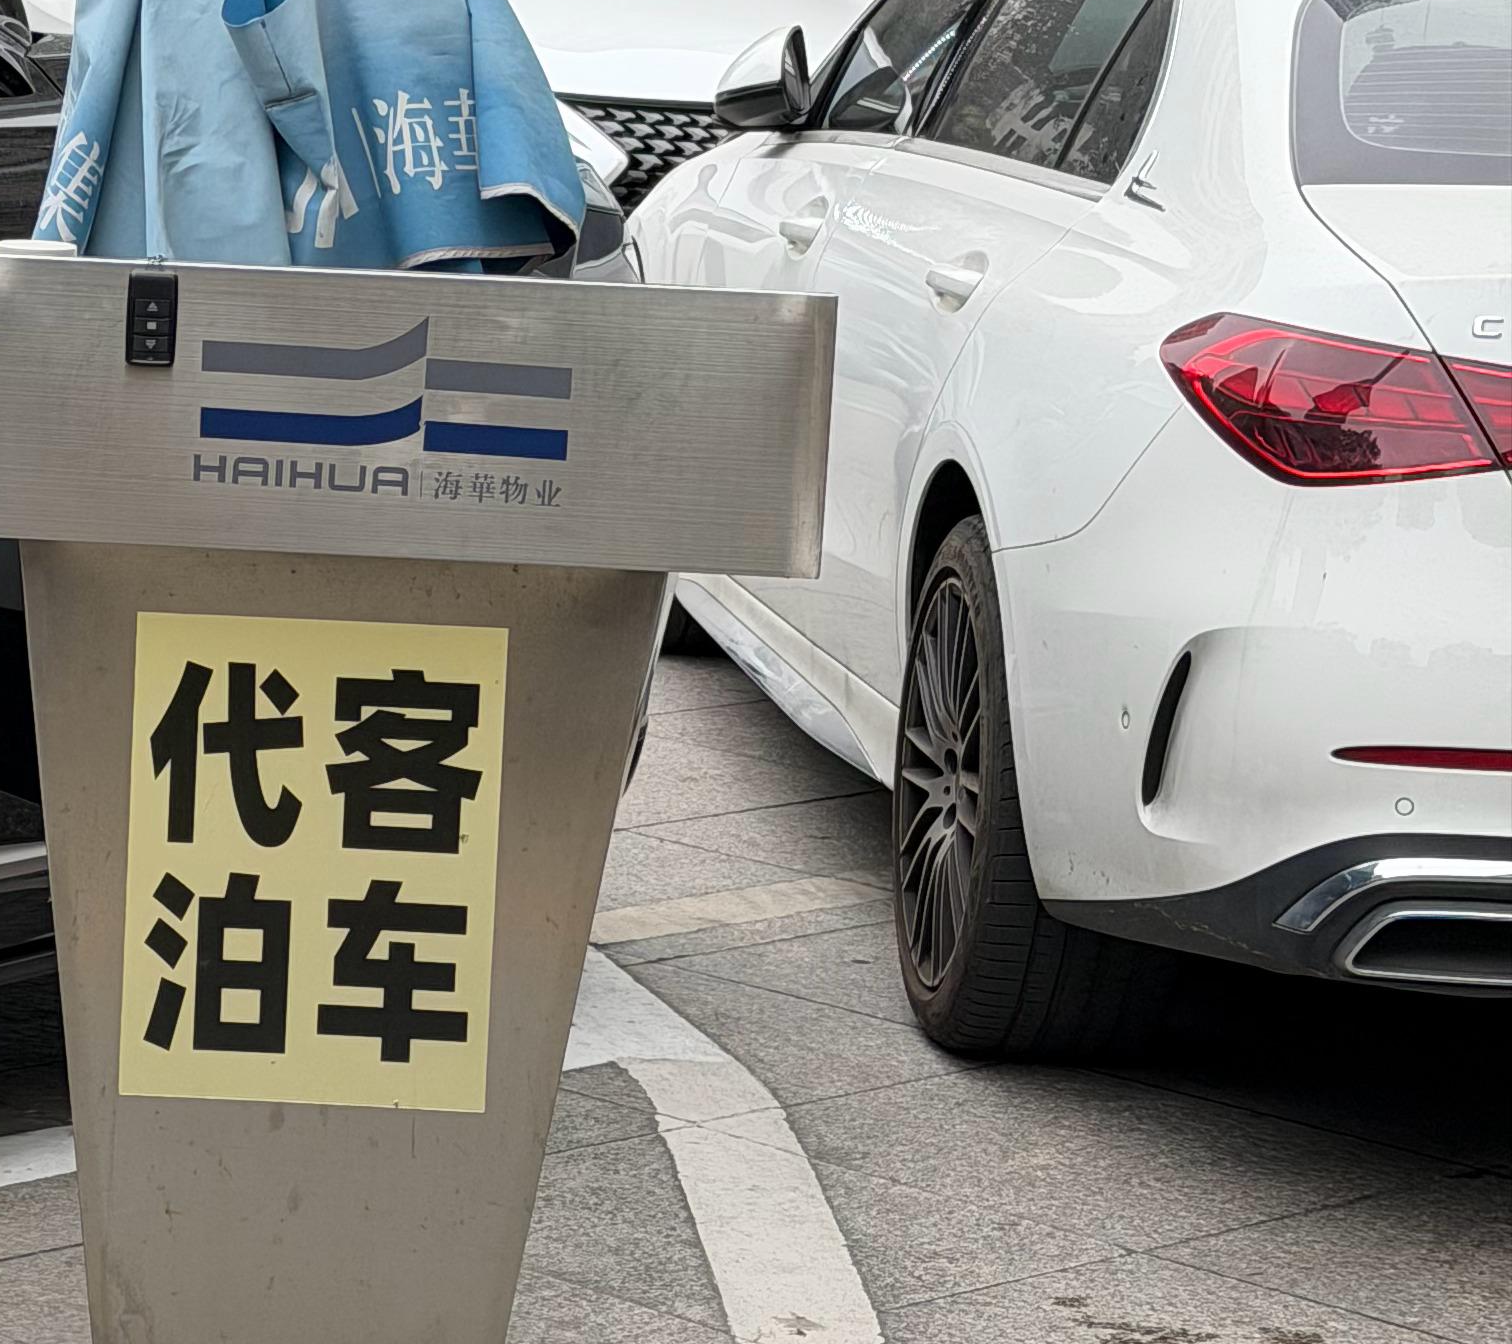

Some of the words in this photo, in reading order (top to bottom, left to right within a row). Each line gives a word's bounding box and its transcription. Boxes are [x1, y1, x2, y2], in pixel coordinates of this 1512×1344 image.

[192, 453, 410, 497] HAIHUA
[432, 470, 564, 508] 海華物业
[149, 660, 483, 854] 代客
[143, 871, 469, 1063] 泊车
